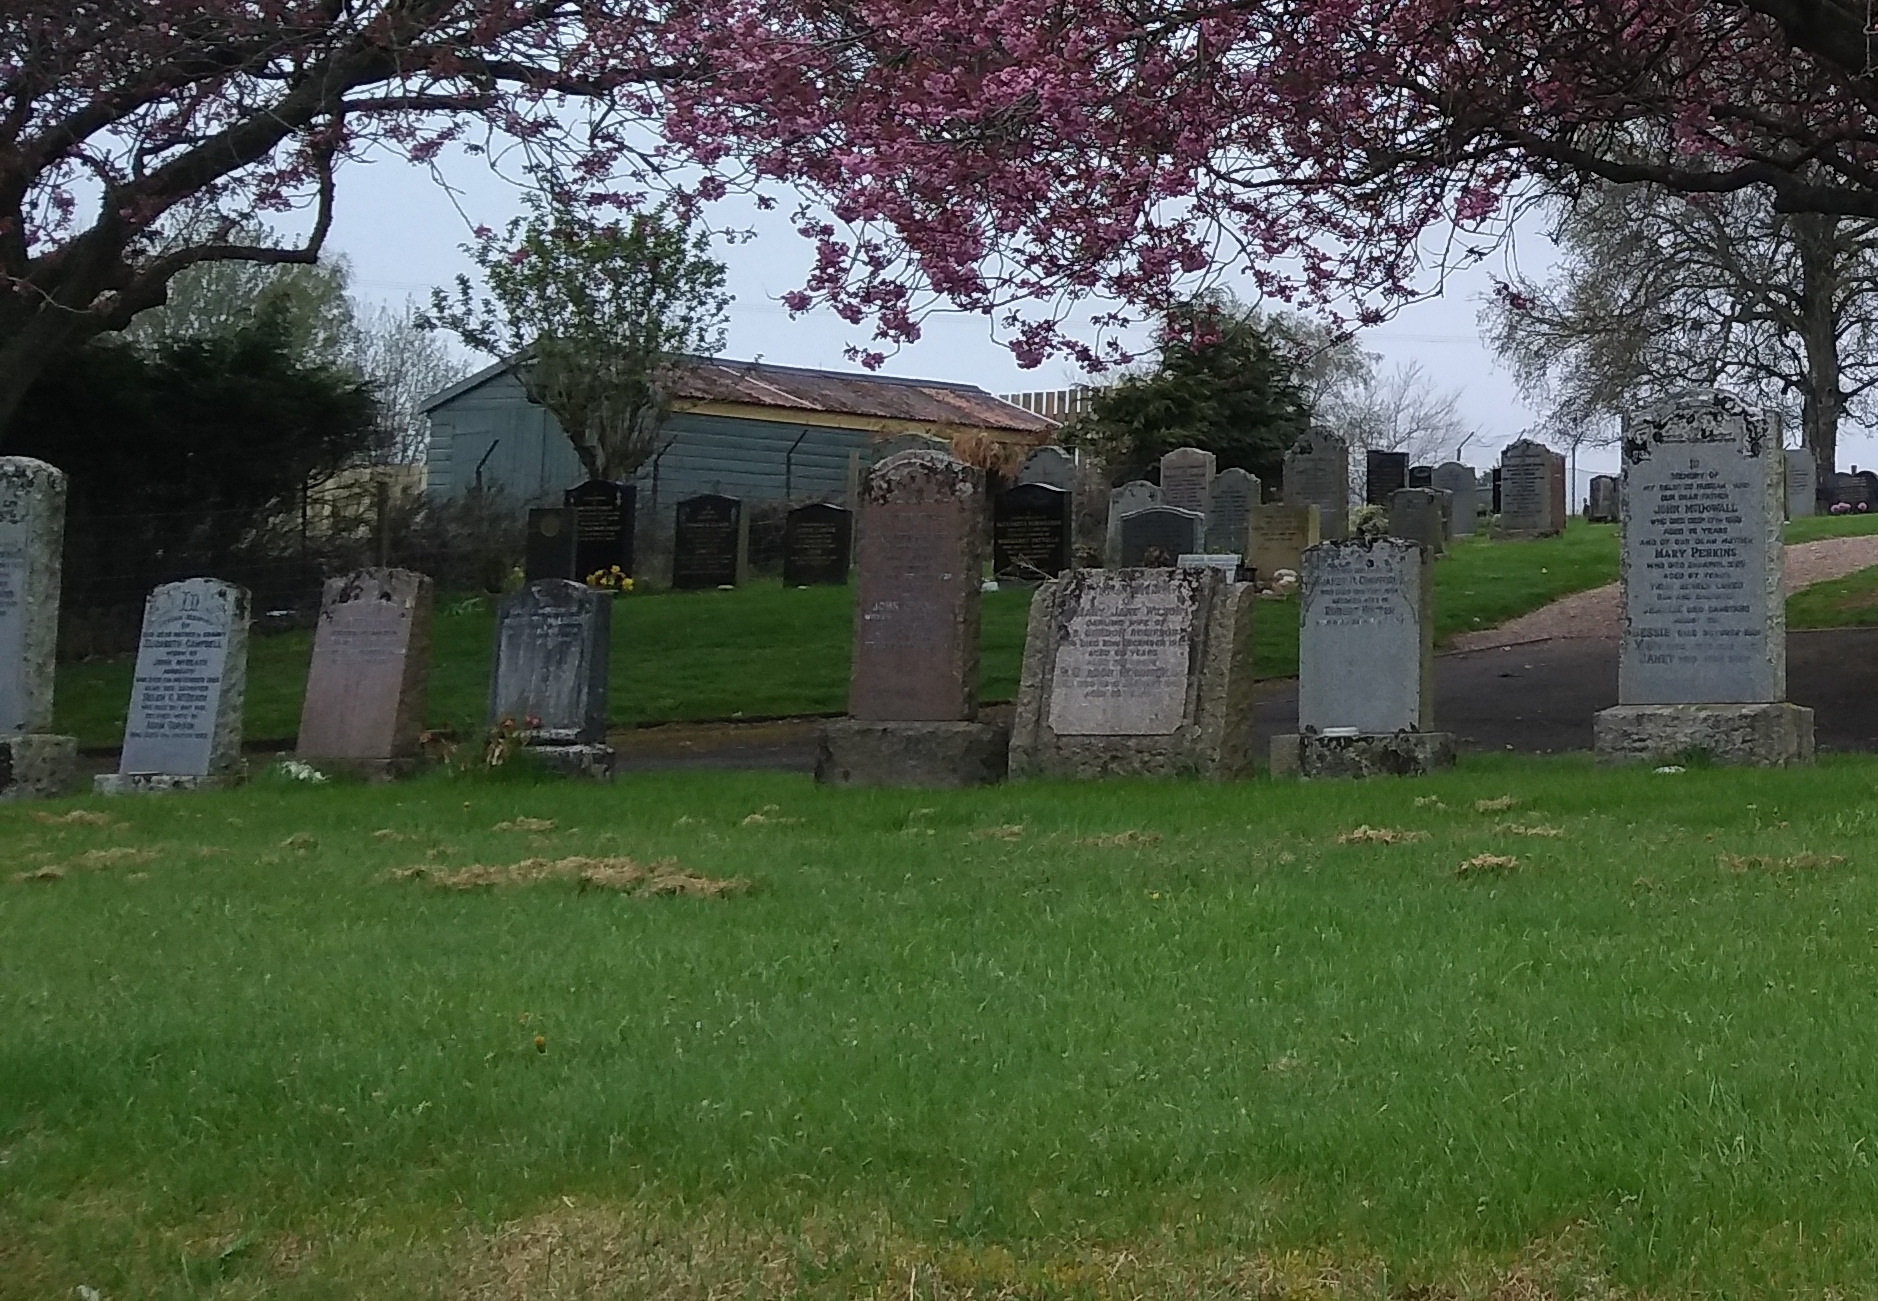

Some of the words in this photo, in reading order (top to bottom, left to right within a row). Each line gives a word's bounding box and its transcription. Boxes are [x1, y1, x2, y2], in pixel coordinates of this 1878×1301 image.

[1653, 505, 1680, 514] JOHN
[1639, 538, 1657, 546] AND
[1654, 548, 1687, 558] MARY
[1690, 547, 1737, 558] PERKINS
[1128, 649, 1158, 657] YEARS
